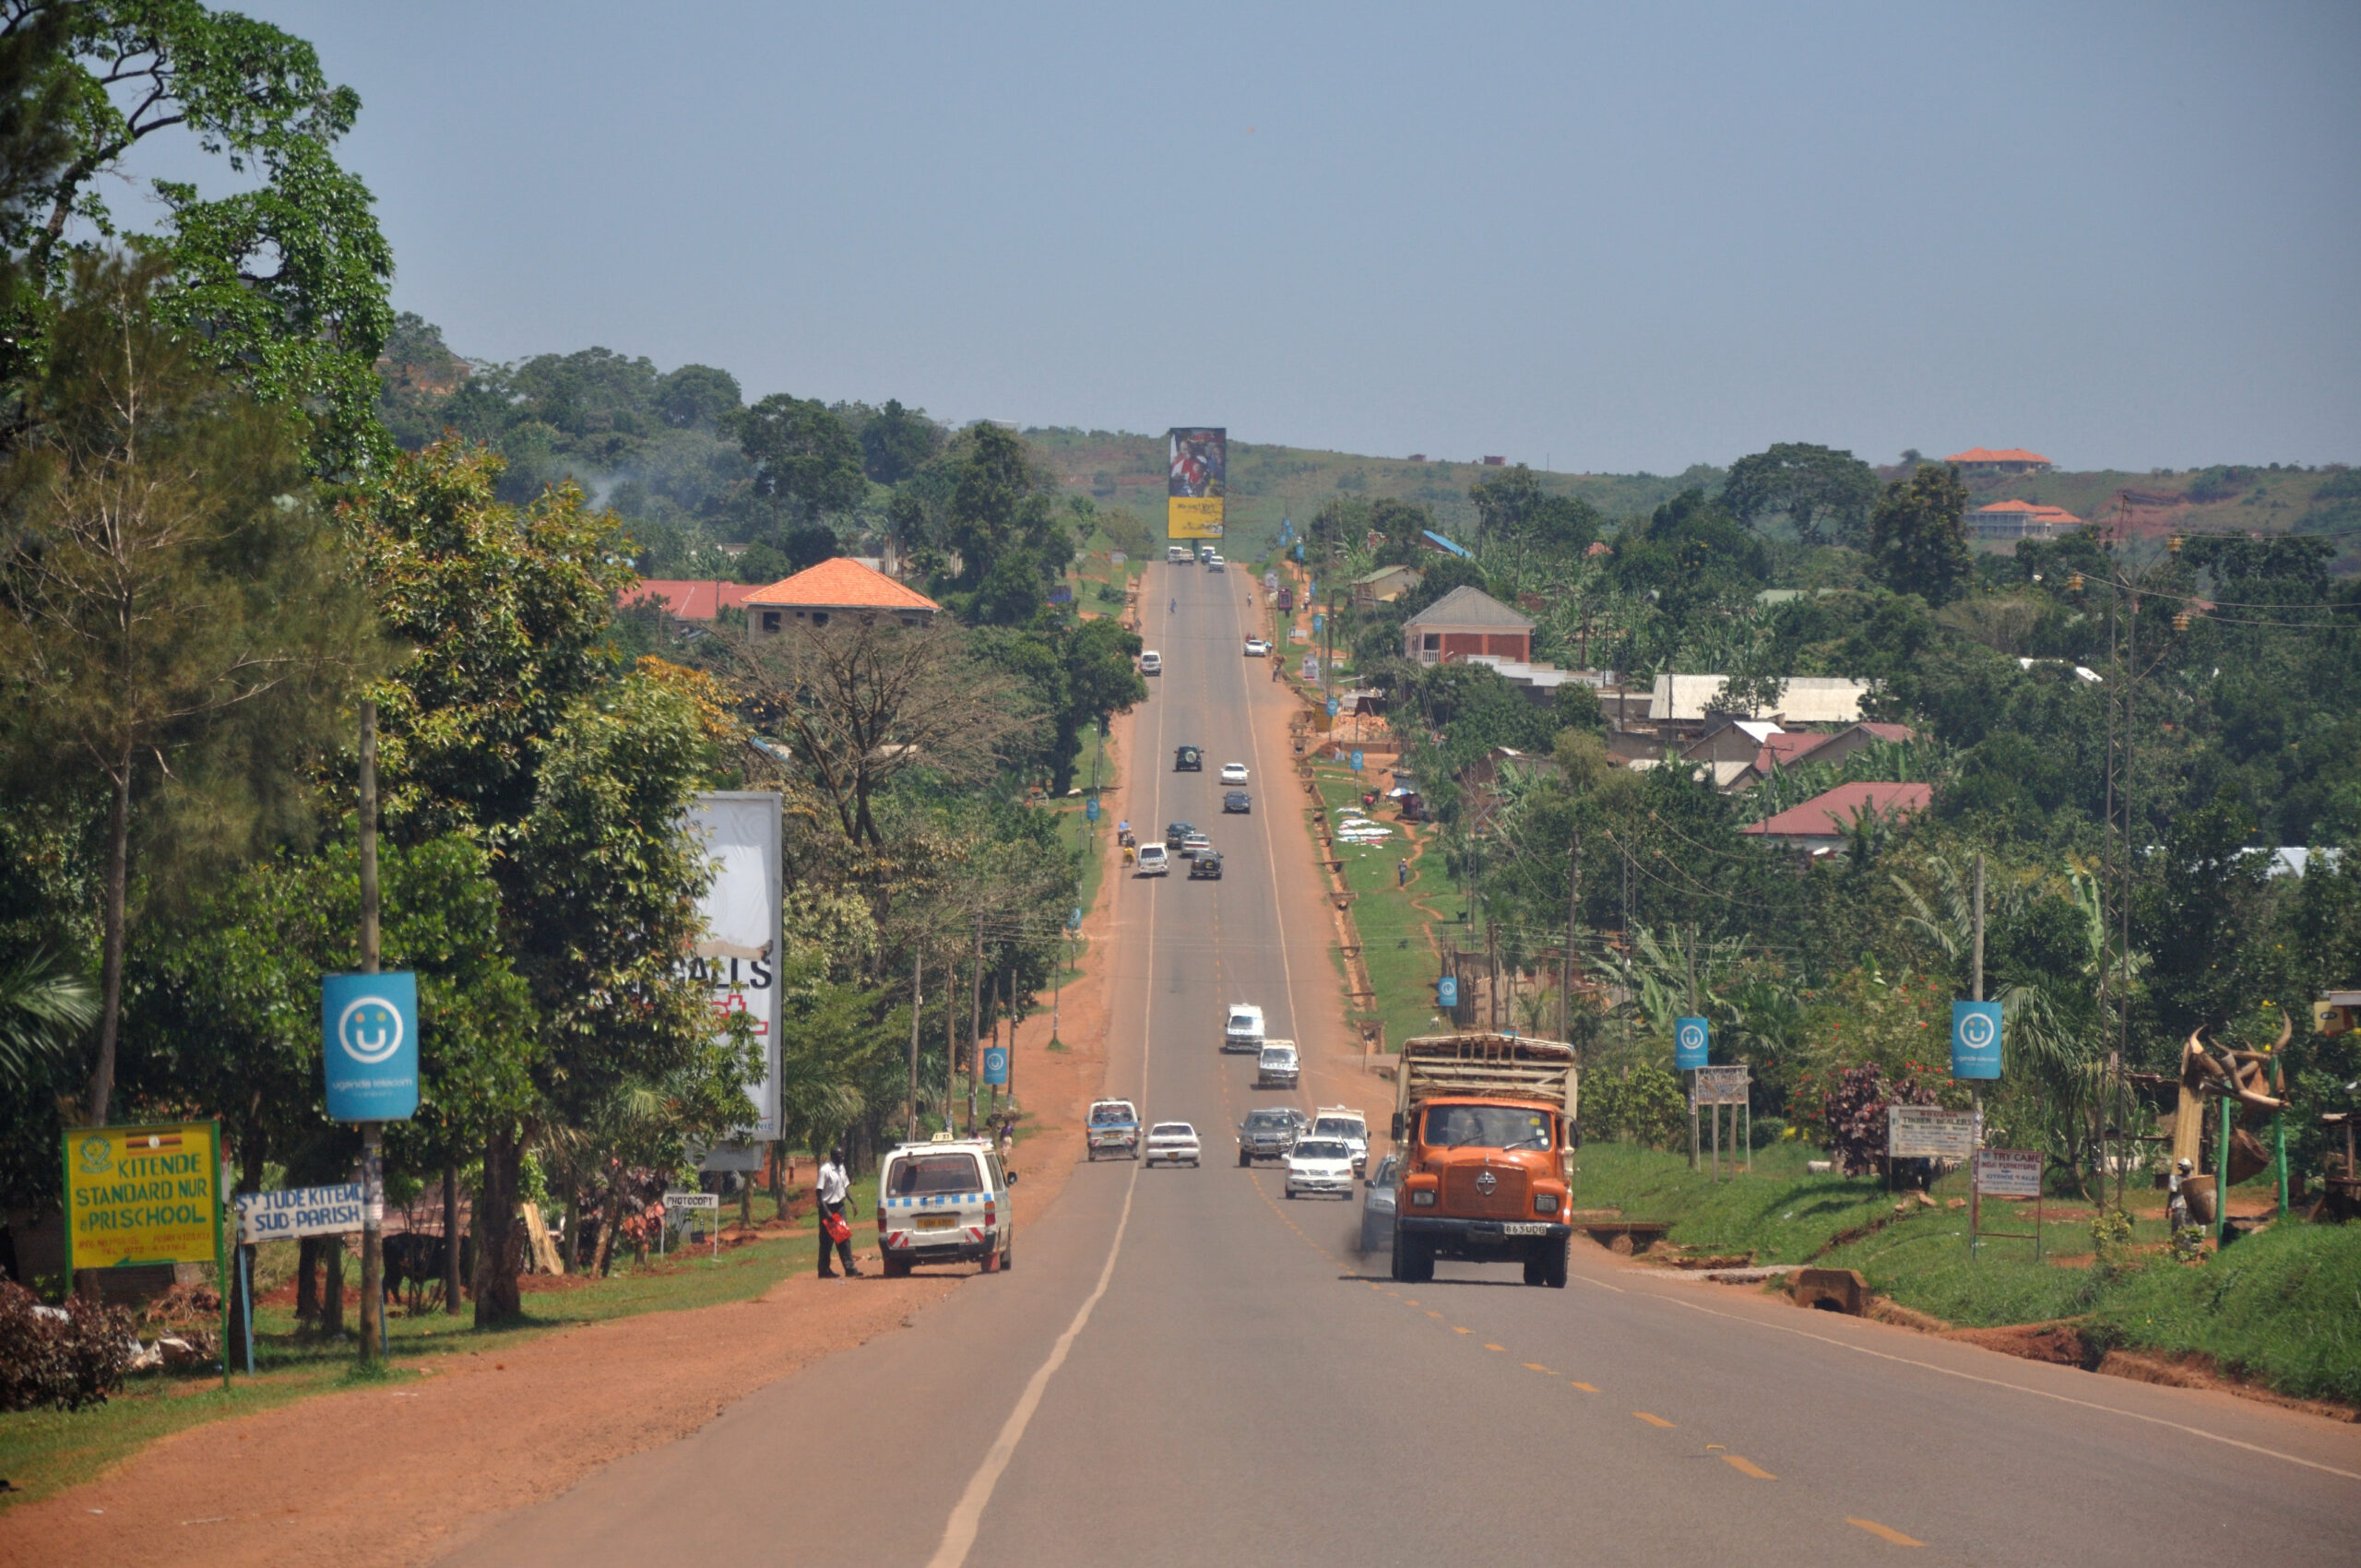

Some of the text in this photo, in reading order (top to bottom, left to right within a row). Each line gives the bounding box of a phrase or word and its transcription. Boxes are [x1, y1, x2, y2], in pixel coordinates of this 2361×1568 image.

[118, 1153, 200, 1179] KITENDE
[2014, 1153, 2040, 1162] CANE
[76, 1178, 208, 1206] STANDARD NUR
[264, 1188, 305, 1210] JUDE
[667, 1196, 713, 1206] PHOTOCOPY
[89, 1209, 117, 1231] PRI
[120, 1204, 207, 1229] SCHOOL
